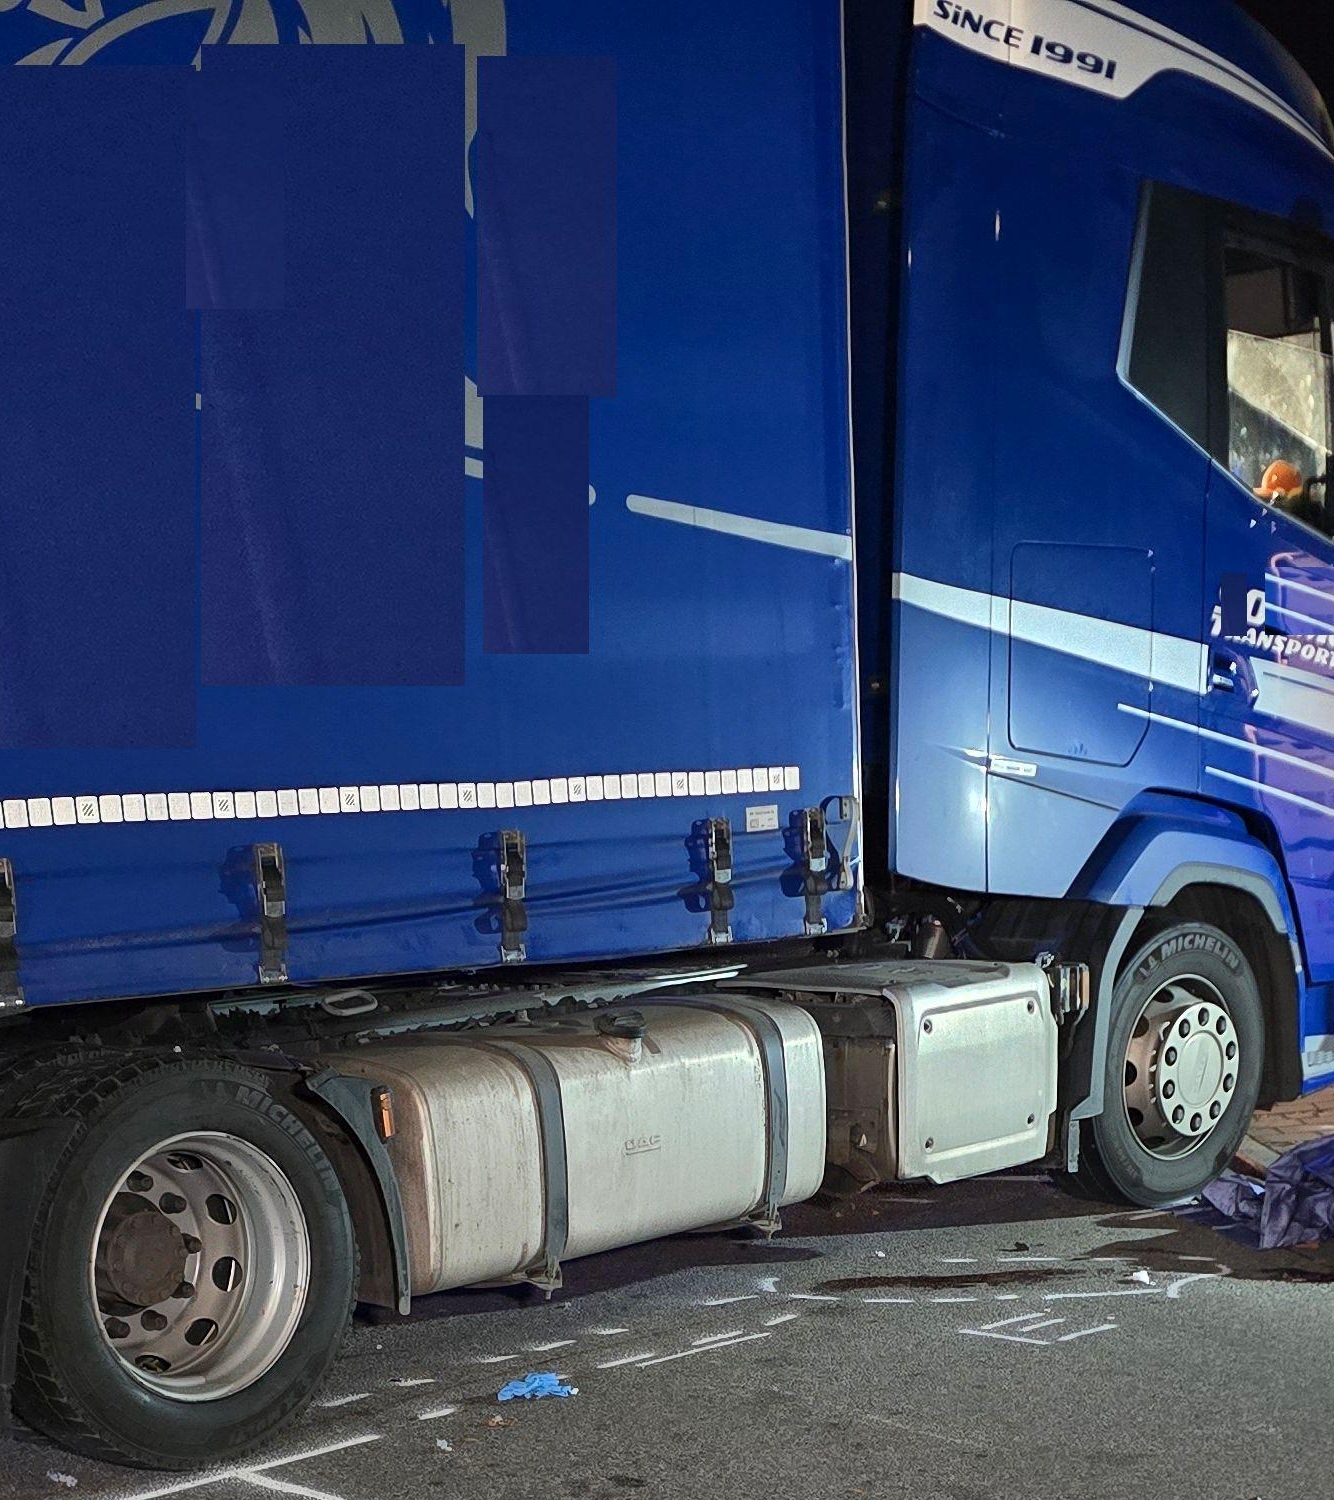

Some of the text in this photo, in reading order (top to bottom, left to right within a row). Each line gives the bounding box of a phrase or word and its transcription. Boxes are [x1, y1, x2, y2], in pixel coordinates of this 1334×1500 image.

[1031, 35, 1117, 79] 1991
[1161, 934, 1240, 969] MICHELIN
[235, 1085, 343, 1195] MICHELIN
